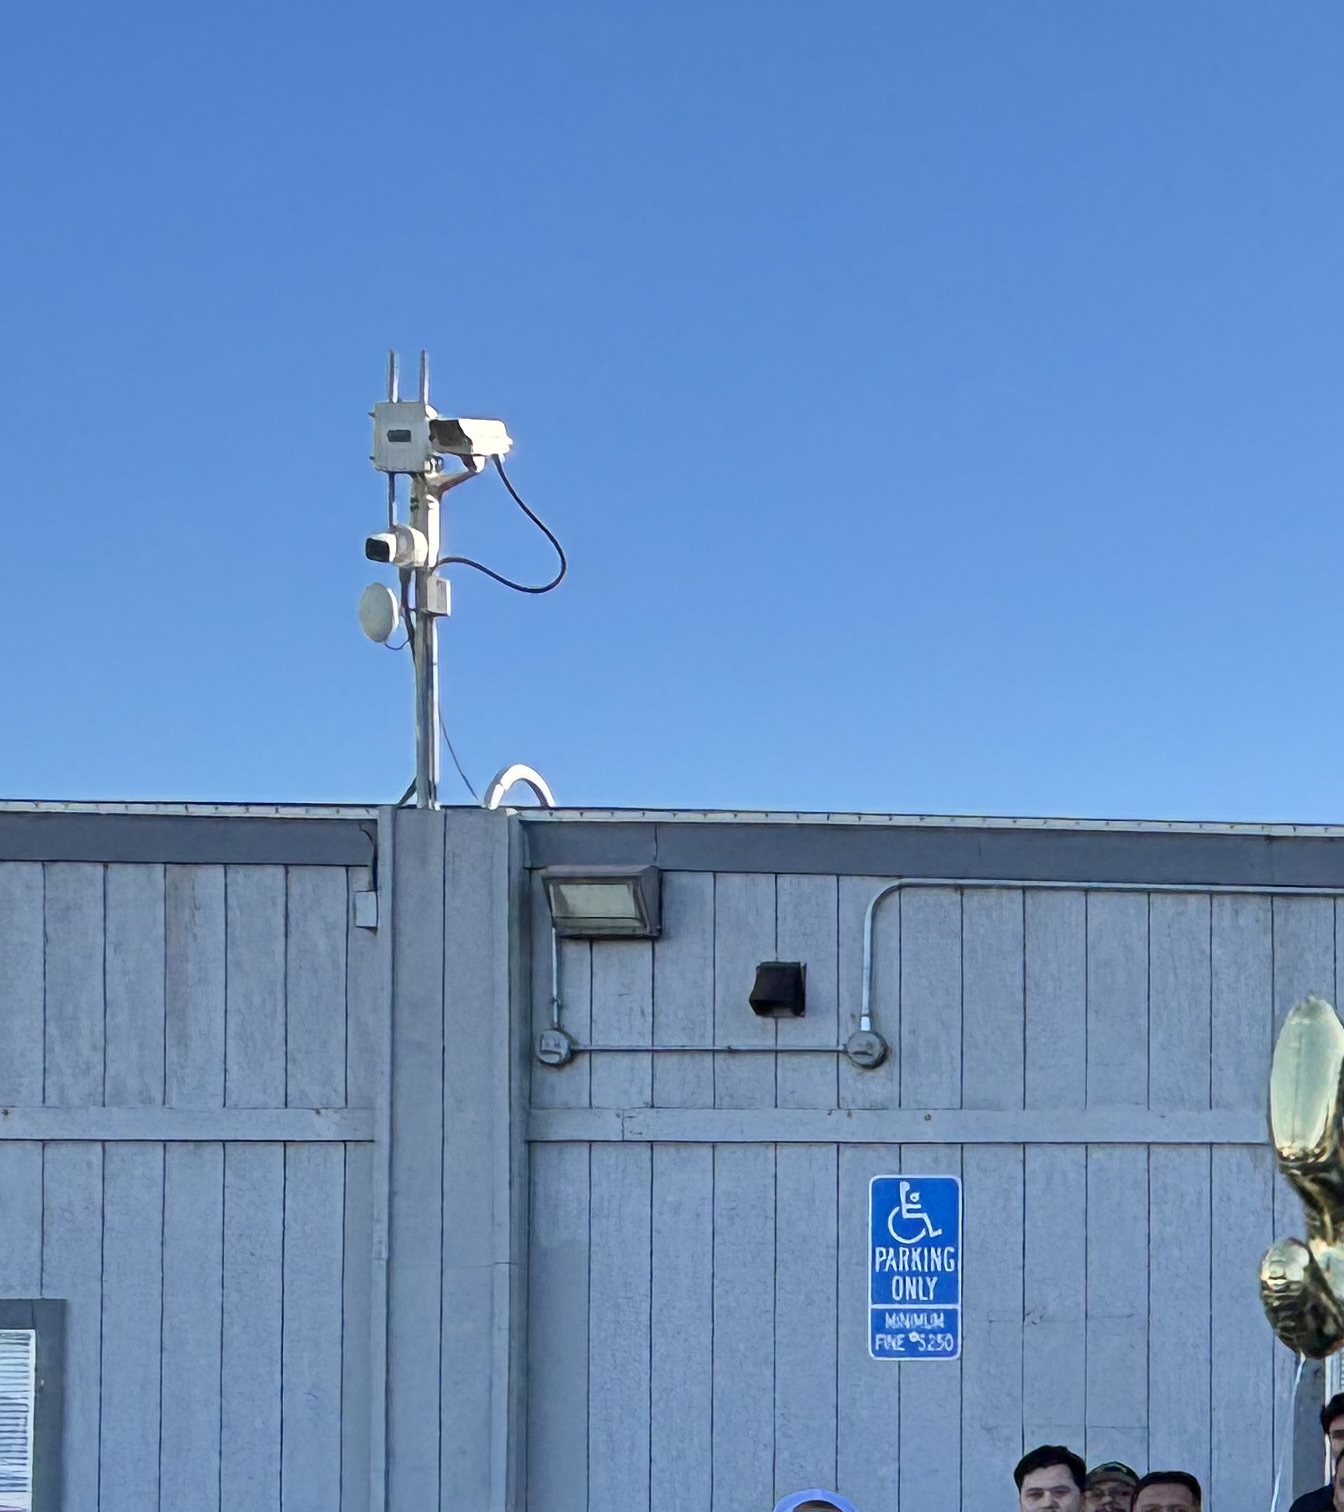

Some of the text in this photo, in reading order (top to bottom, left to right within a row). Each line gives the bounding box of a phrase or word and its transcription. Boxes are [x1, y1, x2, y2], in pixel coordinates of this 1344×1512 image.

[875, 1247, 955, 1272] PARKING
[891, 1276, 938, 1301] ONLY
[885, 1312, 945, 1329] MINIMUM
[875, 1333, 904, 1351] FINE
